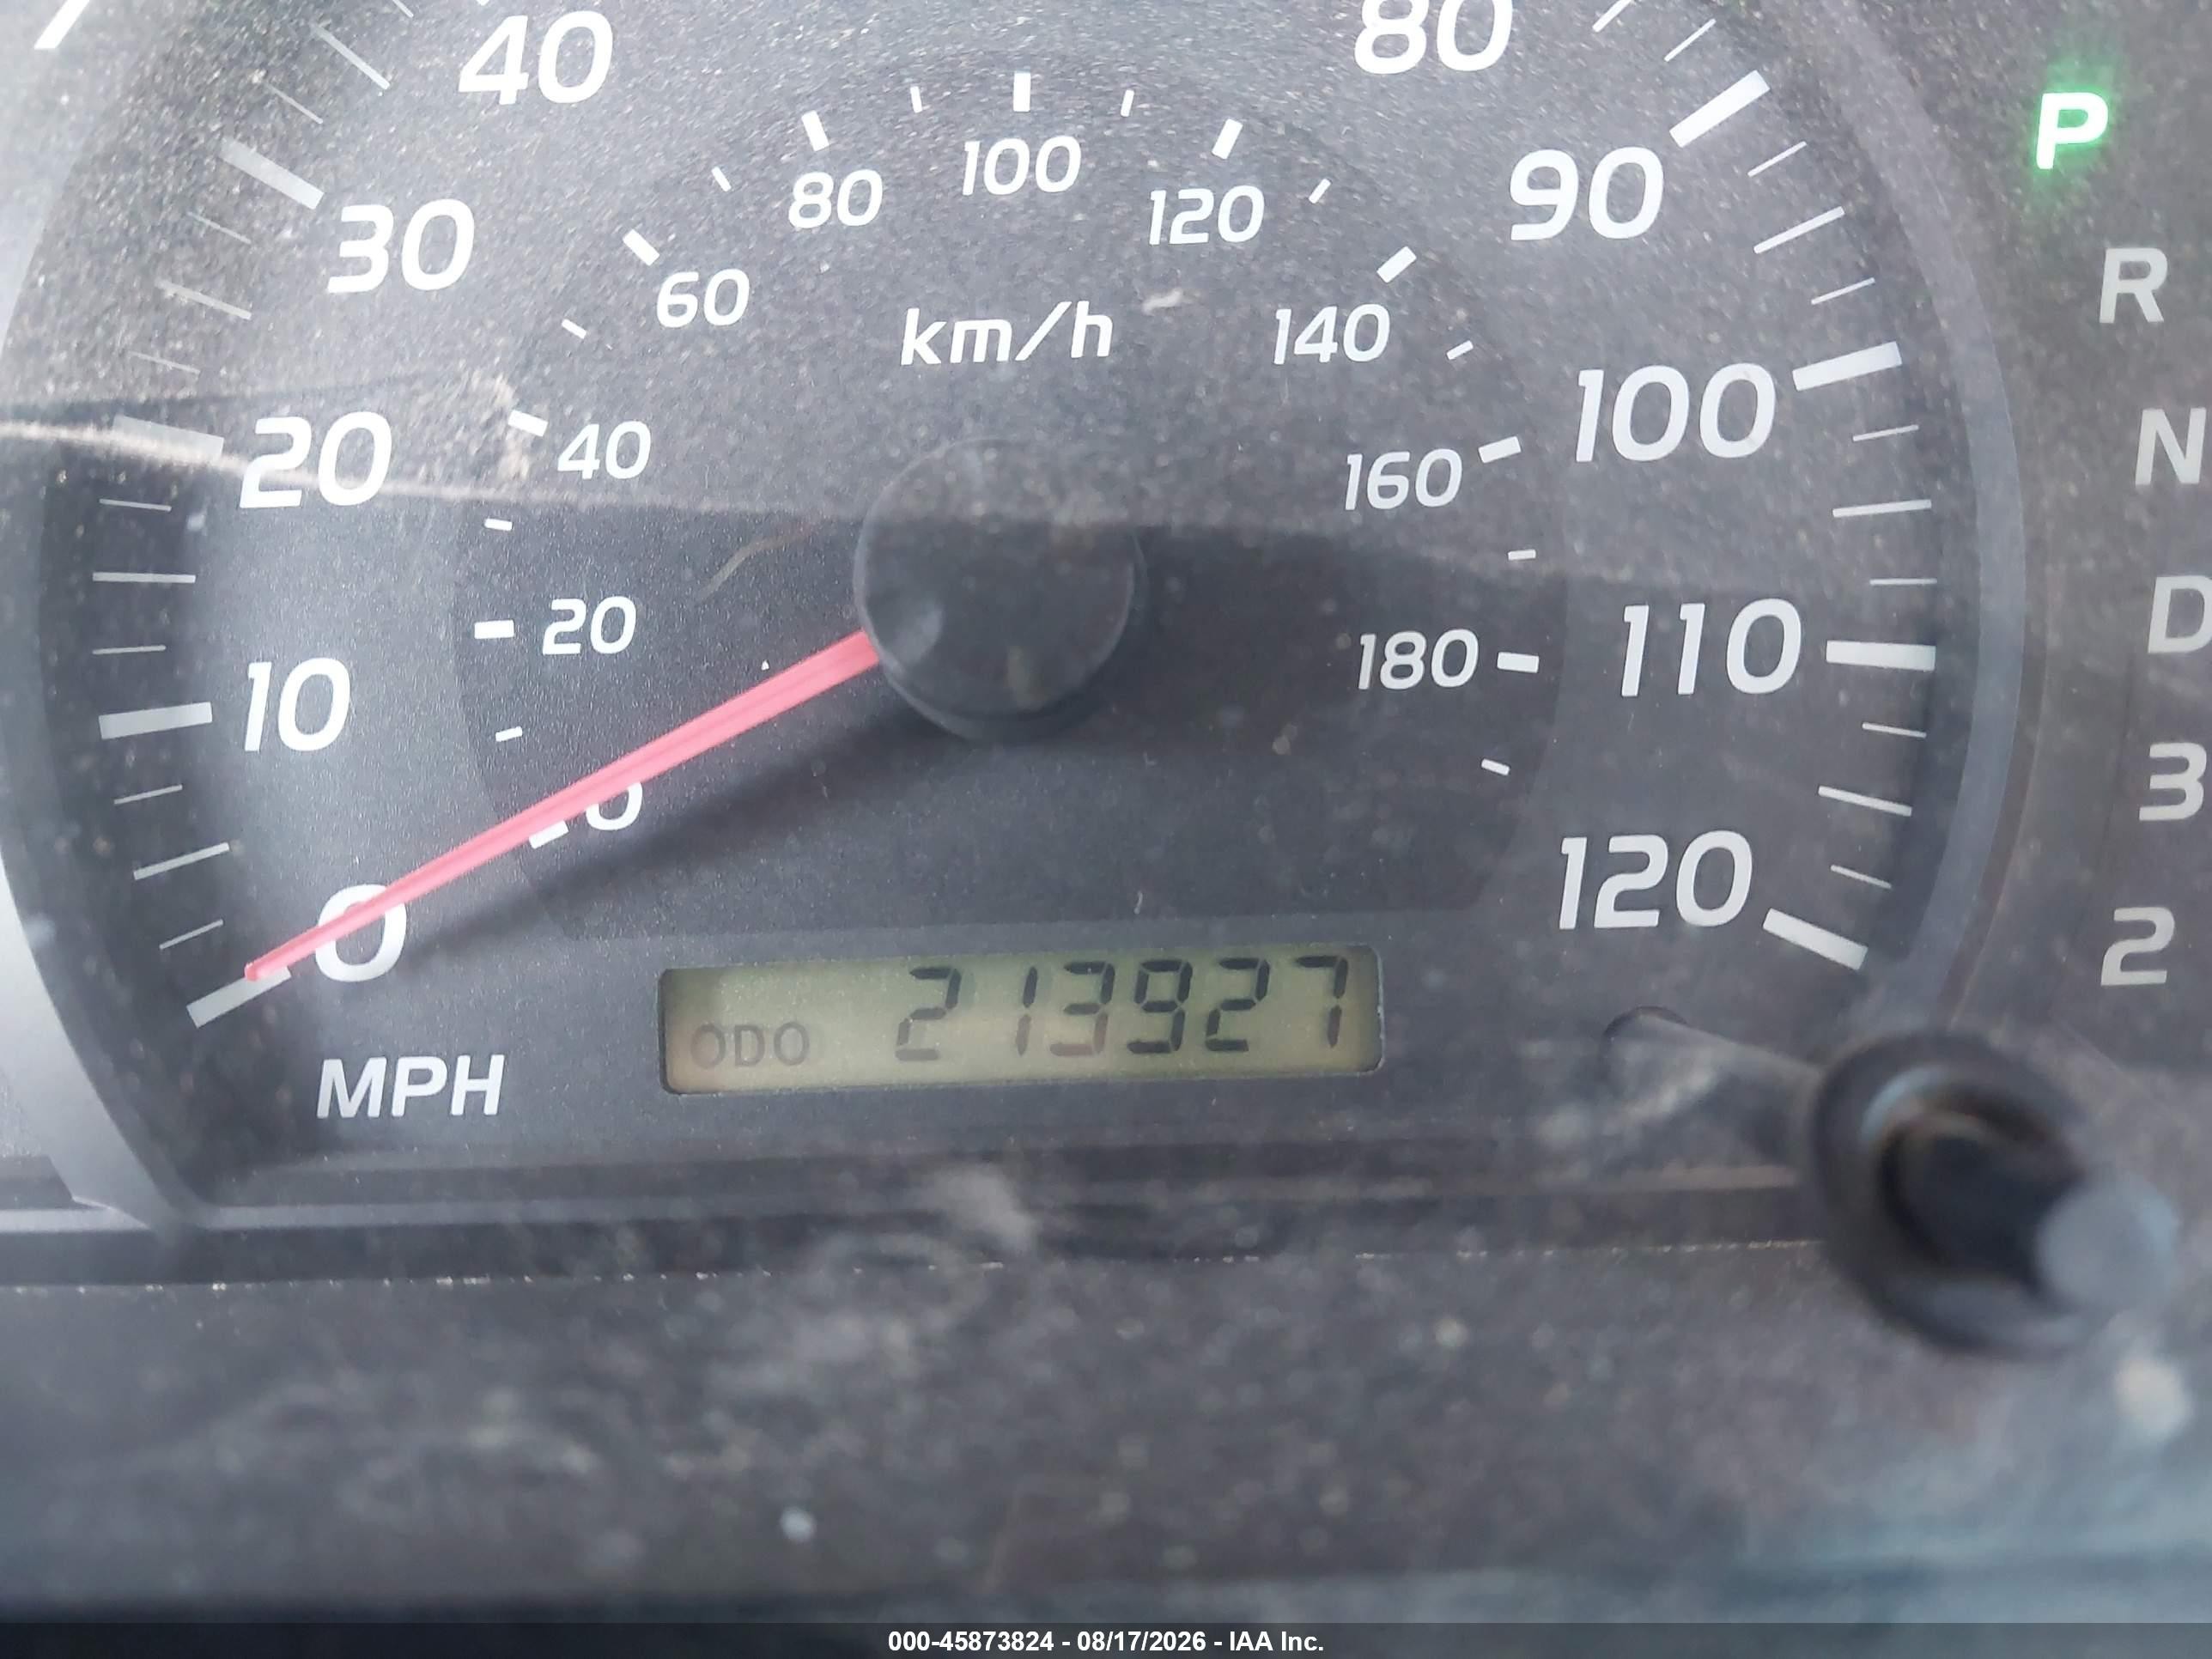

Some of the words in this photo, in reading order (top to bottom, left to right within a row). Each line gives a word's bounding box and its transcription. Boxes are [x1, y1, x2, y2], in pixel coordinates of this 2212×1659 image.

[459, 11, 612, 105] 40
[1354, 0, 1513, 74] 80
[963, 136, 1081, 195] 100
[2037, 93, 2108, 169] P
[789, 169, 883, 228] 80
[1150, 185, 1264, 245] 120
[1510, 147, 1663, 240] 90
[327, 199, 474, 294] 30
[657, 269, 750, 327] 60
[2100, 247, 2167, 323] R
[902, 301, 1112, 365] km/h
[1274, 304, 1389, 364] 140
[558, 421, 651, 479] 40
[1577, 363, 1775, 461] 100
[2136, 408, 2206, 484] N
[239, 411, 393, 507] 20
[1346, 449, 1462, 509] 160
[543, 597, 635, 654] 20
[1622, 599, 1801, 696] 110
[2148, 575, 2212, 653] D
[1359, 629, 1478, 689] 180
[246, 658, 349, 750] 10
[2140, 743, 2206, 820] 3
[1559, 831, 1752, 929] 120
[315, 884, 407, 981] 0
[2101, 907, 2174, 985] 2
[690, 1022, 810, 1067] ODO
[895, 956, 1348, 1063] 213927
[319, 1054, 504, 1116] MPH
